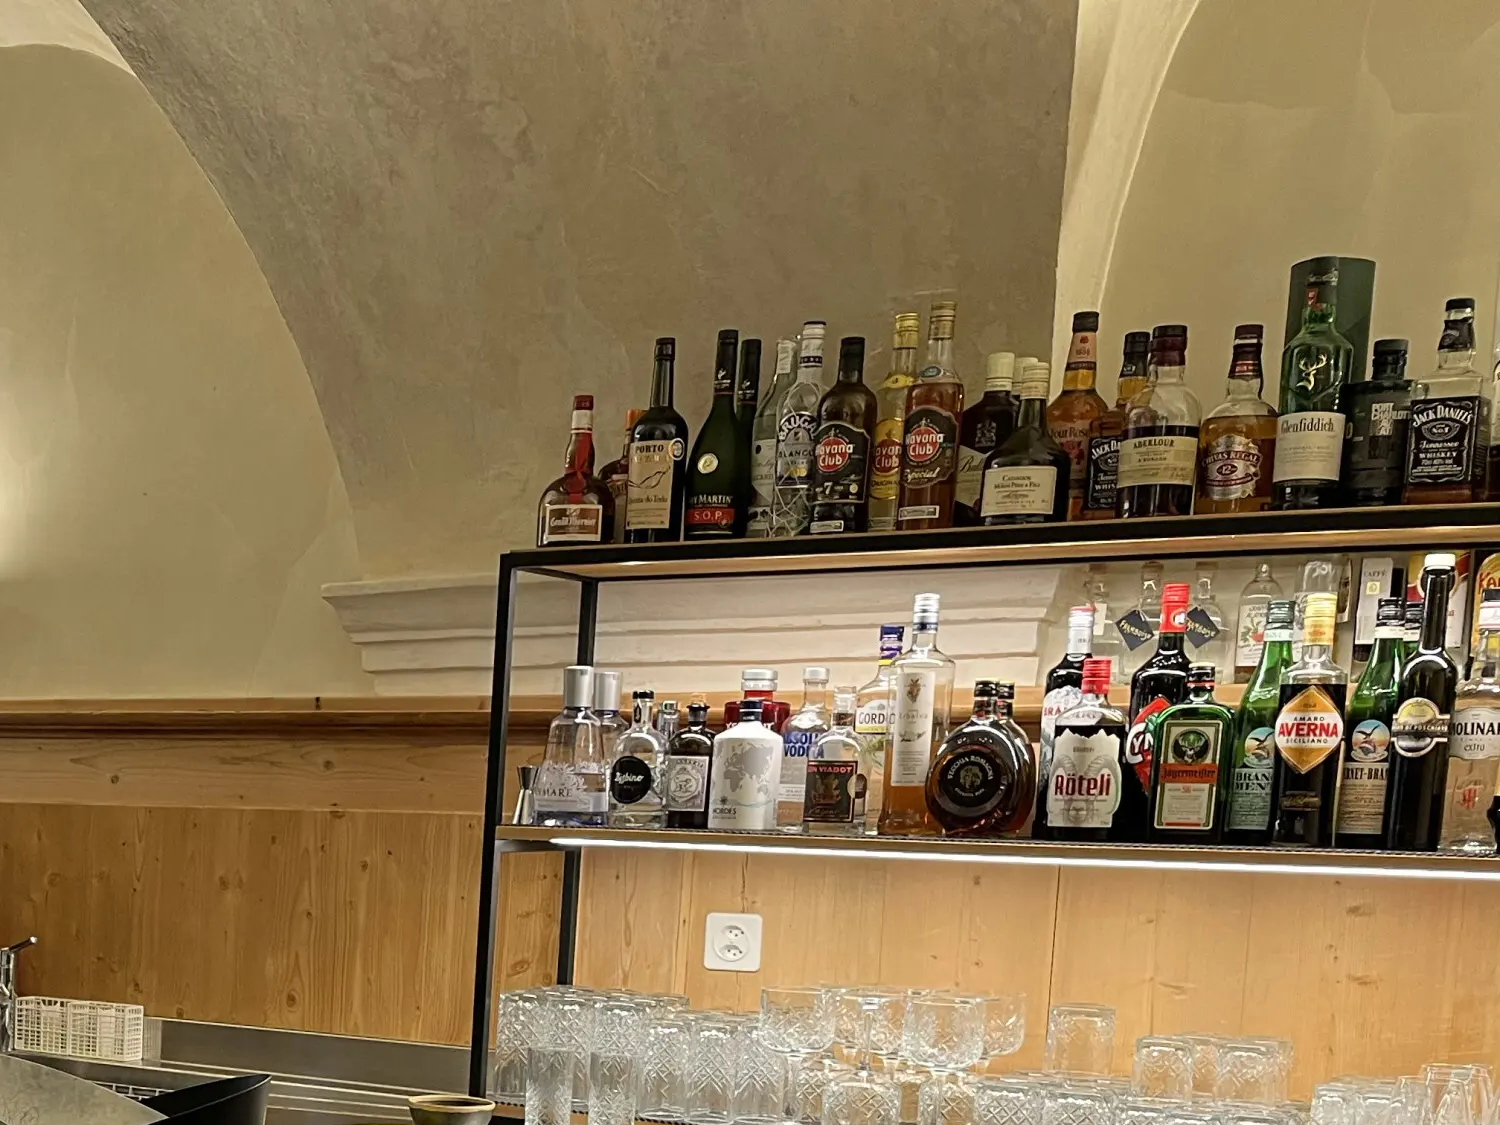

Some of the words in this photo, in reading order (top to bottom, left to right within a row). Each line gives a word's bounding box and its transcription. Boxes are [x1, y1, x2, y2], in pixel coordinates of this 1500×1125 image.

[1413, 407, 1437, 428] JACK
[779, 415, 818, 441] BRUGA
[1280, 417, 1334, 434] Glenfiddich
[635, 444, 664, 453] PORTO
[909, 443, 934, 456] Club
[819, 454, 843, 467] Club
[1222, 464, 1232, 474] 12
[698, 494, 733, 504] MARTIN
[693, 510, 723, 520] S.O.P
[1277, 722, 1339, 738] AVERNA
[1449, 721, 1500, 736] MOLINA
[1163, 767, 1217, 780] Jägermeister
[1236, 771, 1270, 783] BRAN
[1054, 773, 1112, 797] Röteli
